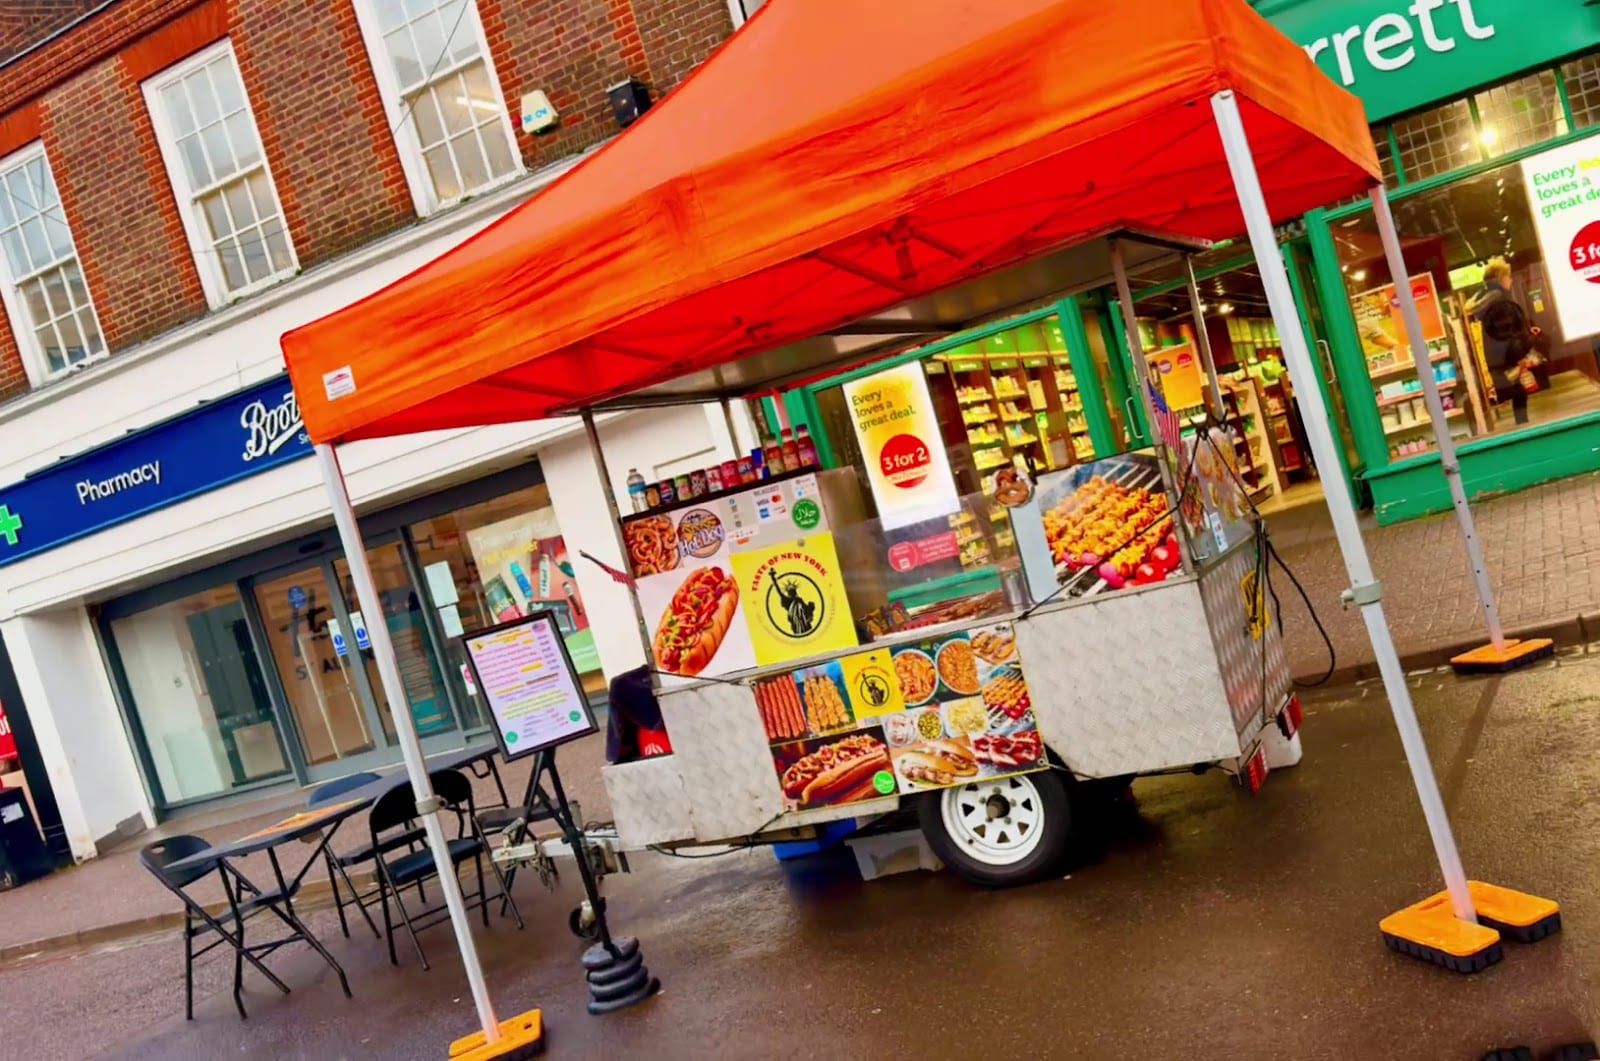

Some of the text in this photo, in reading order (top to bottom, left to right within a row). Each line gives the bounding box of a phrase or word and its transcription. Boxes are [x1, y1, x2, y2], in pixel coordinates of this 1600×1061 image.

[1302, 0, 1495, 86] rrett
[1533, 156, 1600, 187] Every bo
[1536, 176, 1591, 200] loves a
[1541, 187, 1600, 218] great de
[1573, 246, 1587, 265] 3
[851, 389, 883, 407] Every
[855, 400, 893, 418] loves a
[240, 391, 302, 461] Boot
[859, 415, 889, 432] great
[883, 447, 928, 471] 3 for 2
[75, 460, 161, 505] Pharmacy
[680, 533, 702, 557] Hot
[752, 552, 828, 592] TASTE OF NEW YORK
